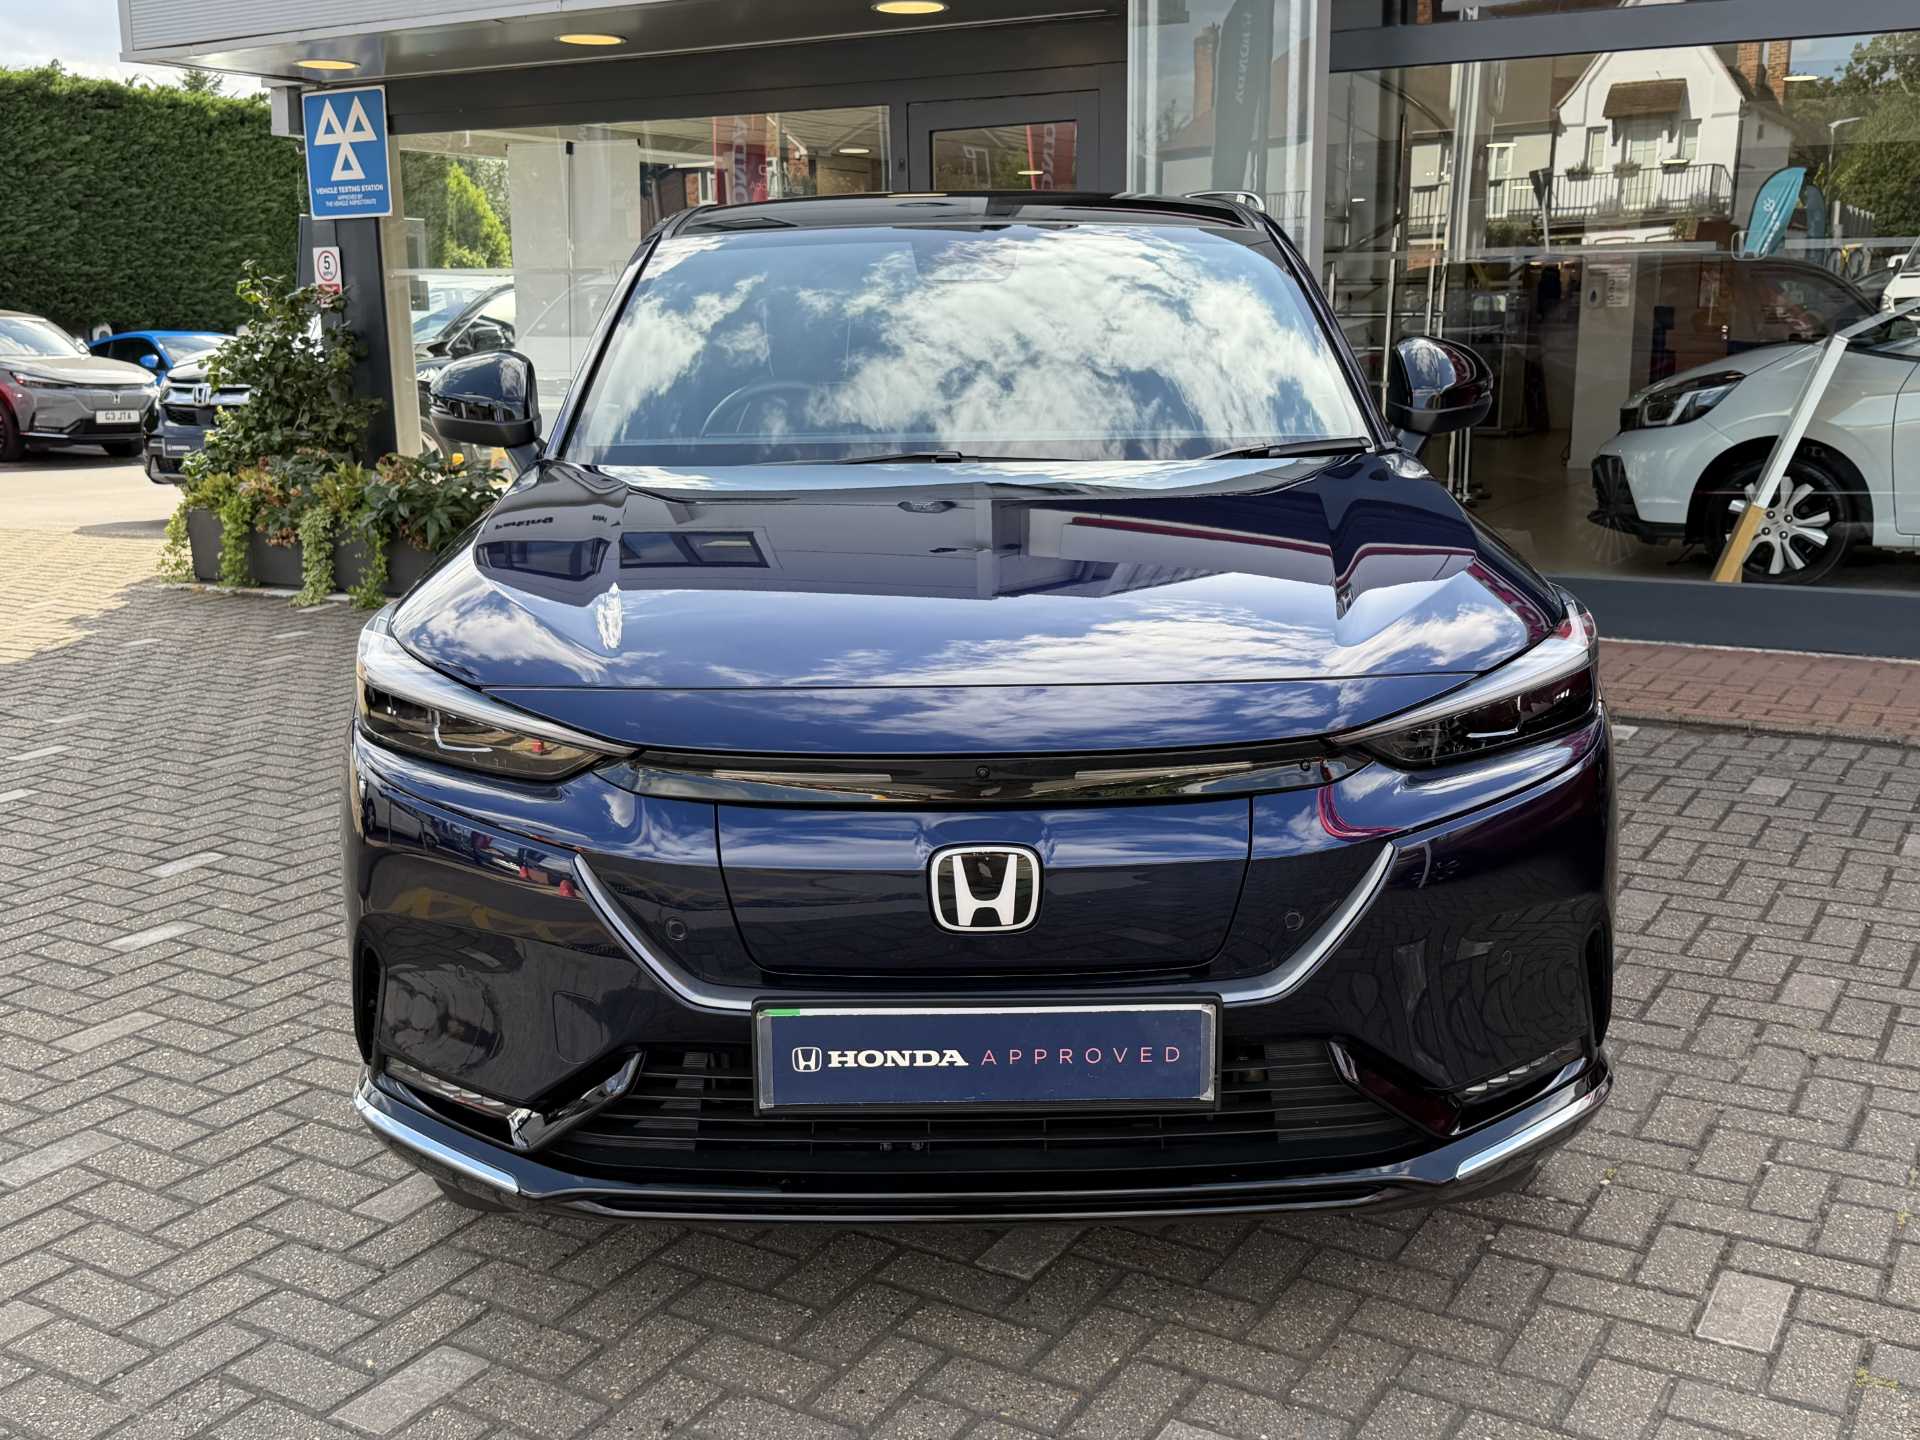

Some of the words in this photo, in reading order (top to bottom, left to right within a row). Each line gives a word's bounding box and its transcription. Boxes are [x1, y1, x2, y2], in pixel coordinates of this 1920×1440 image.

[338, 185, 361, 193] TESTING
[361, 183, 384, 192] STATION
[323, 255, 331, 270] 5
[827, 1049, 969, 1067] HONDA
[981, 1047, 1180, 1066] APPROVED
